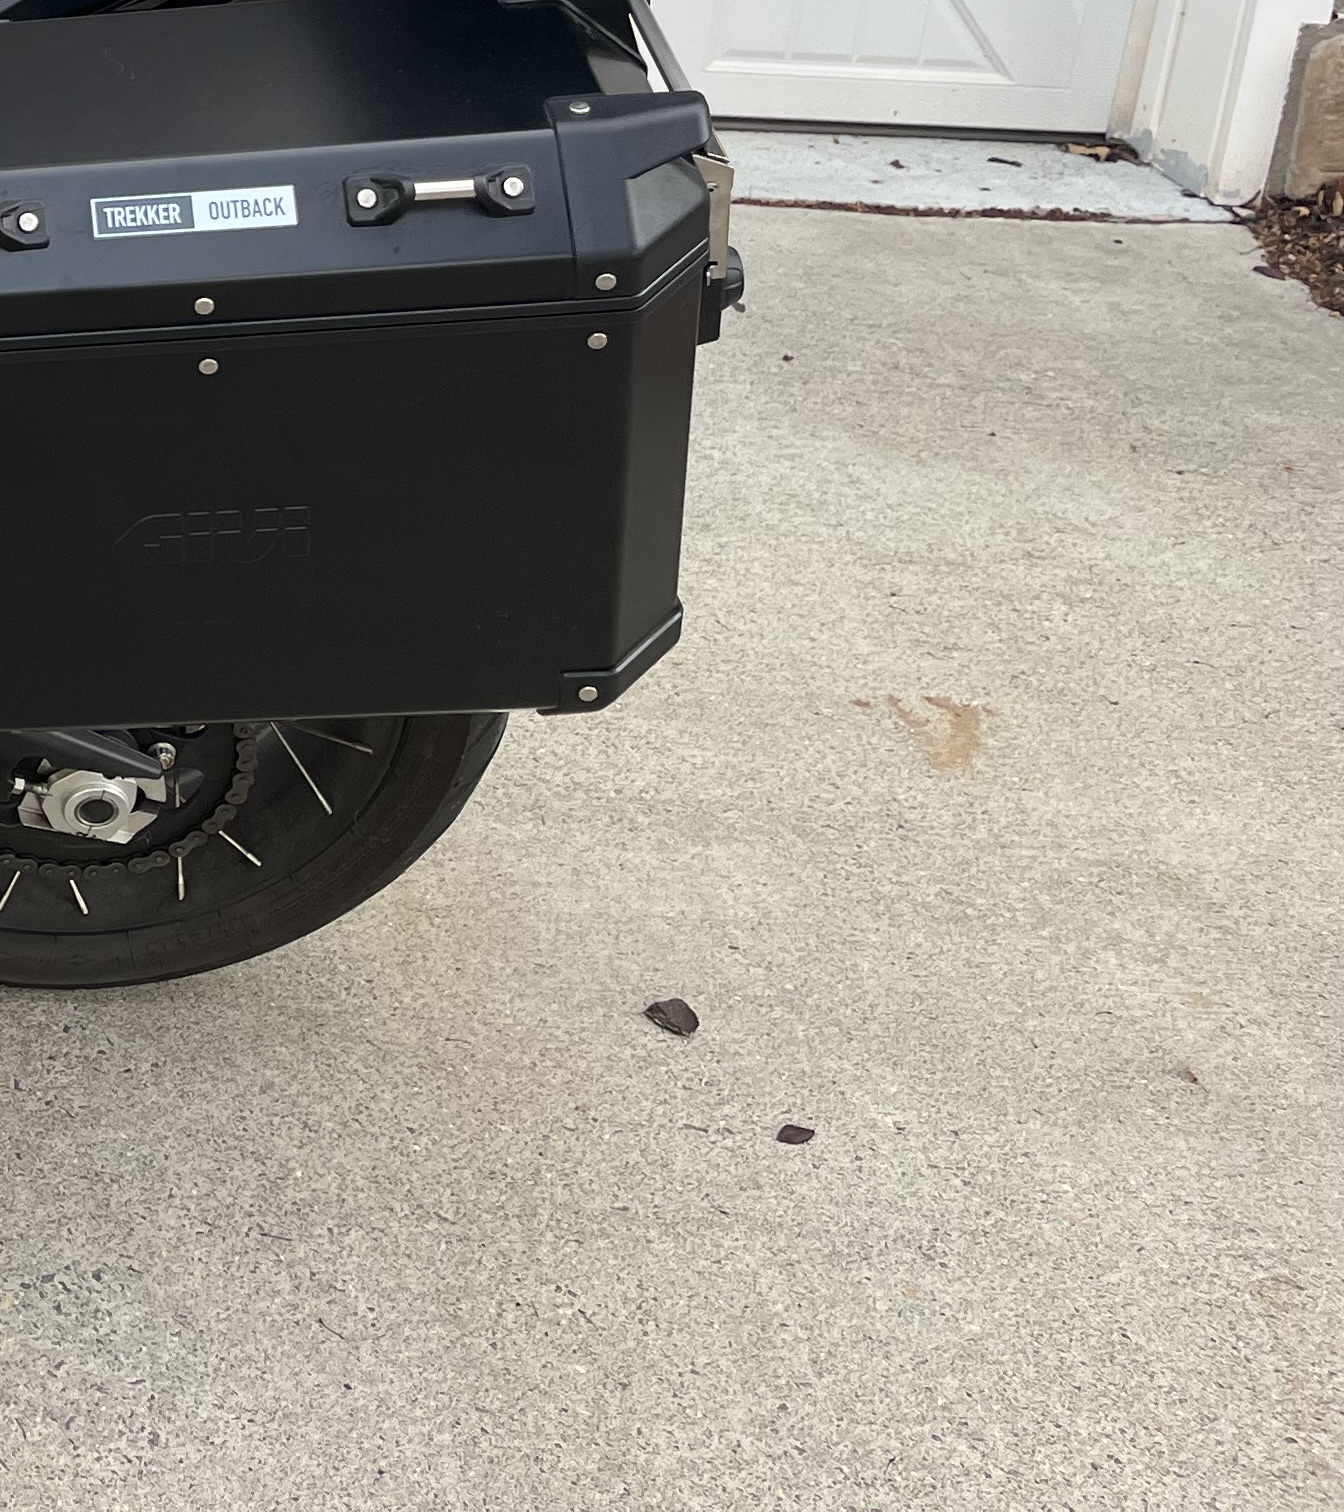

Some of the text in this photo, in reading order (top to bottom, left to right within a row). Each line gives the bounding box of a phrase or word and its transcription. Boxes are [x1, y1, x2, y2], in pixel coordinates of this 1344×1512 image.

[102, 196, 286, 228] TREKKER OUTBACK
[113, 505, 311, 565] GIVI
